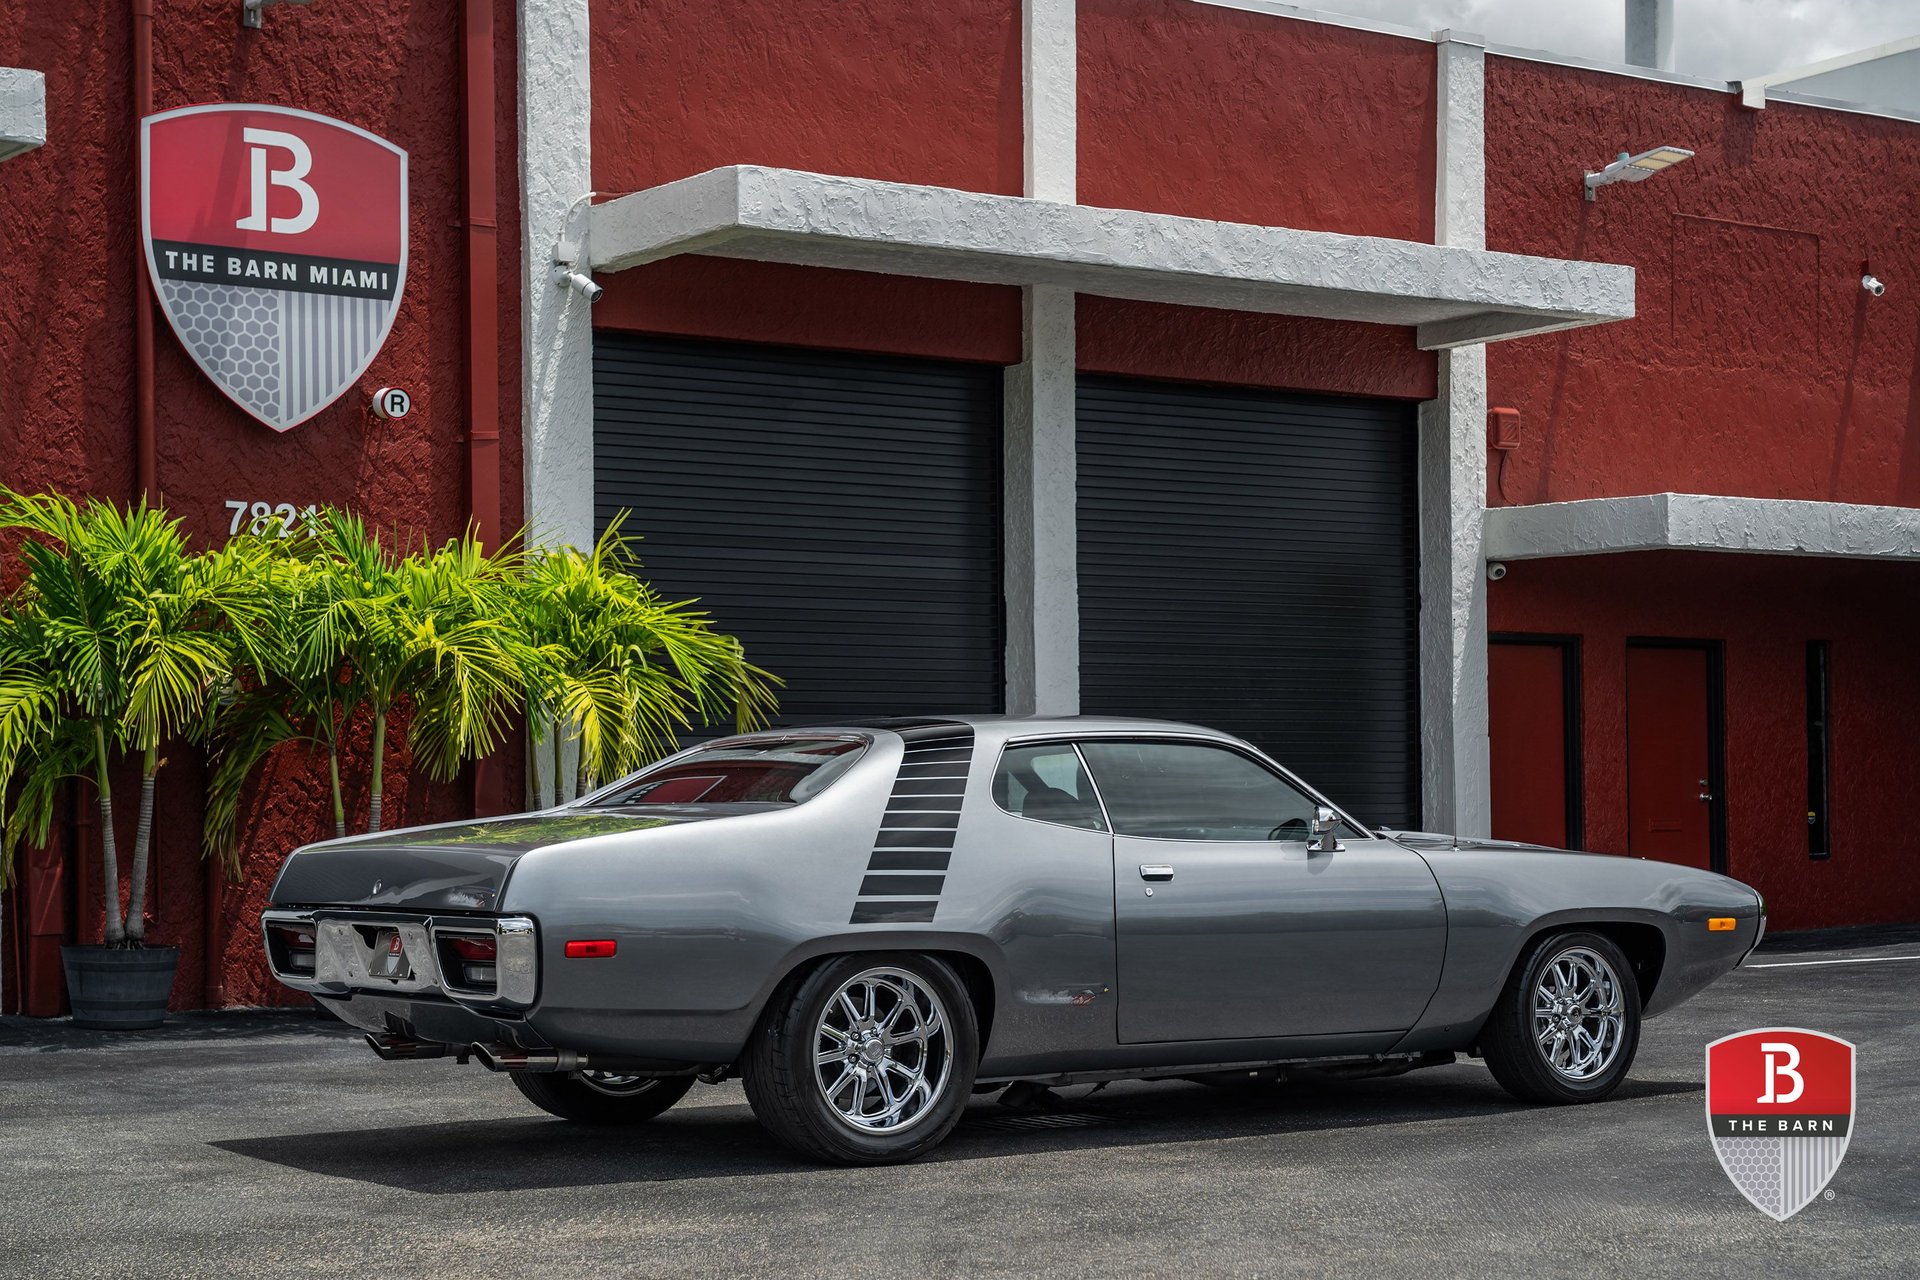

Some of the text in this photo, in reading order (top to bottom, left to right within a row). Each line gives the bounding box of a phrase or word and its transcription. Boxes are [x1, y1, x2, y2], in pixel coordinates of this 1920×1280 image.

[236, 127, 320, 234] B
[165, 250, 388, 290] THE BARN MIAMI
